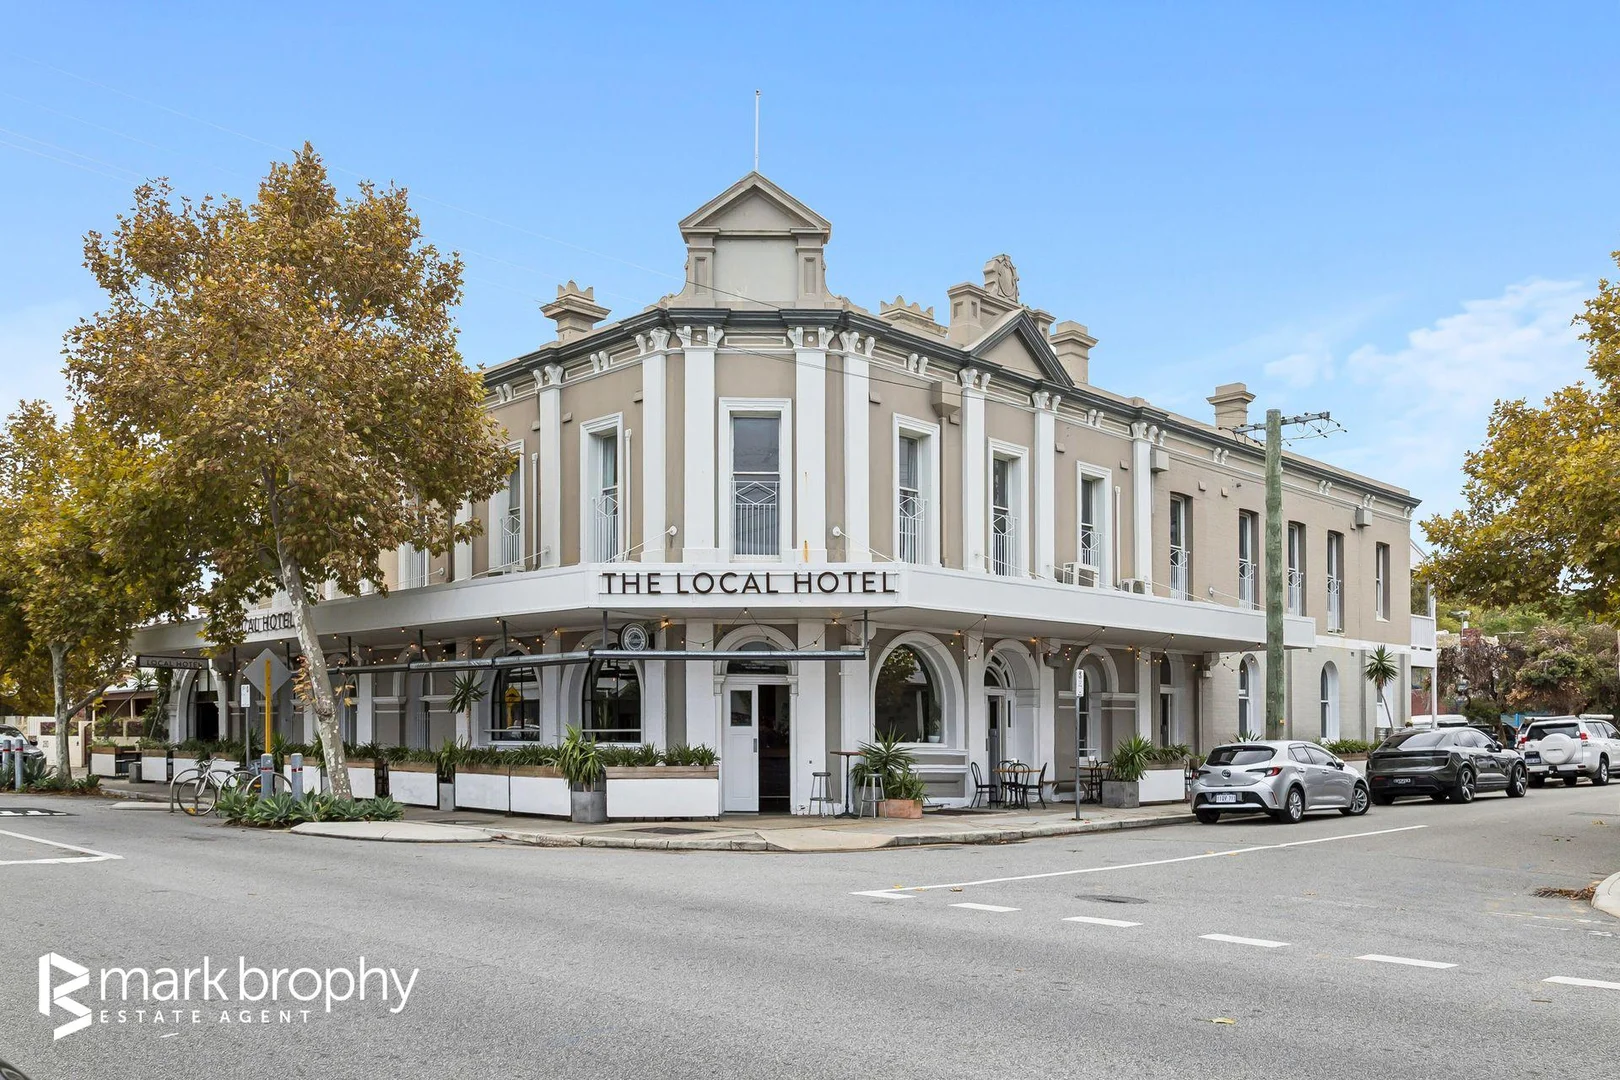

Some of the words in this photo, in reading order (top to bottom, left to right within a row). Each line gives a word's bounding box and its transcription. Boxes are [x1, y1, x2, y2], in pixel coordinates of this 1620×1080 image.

[602, 572, 661, 594] THE
[676, 572, 778, 594] LOCAL
[794, 571, 895, 594] HOTEL
[262, 611, 295, 632] HOTEL
